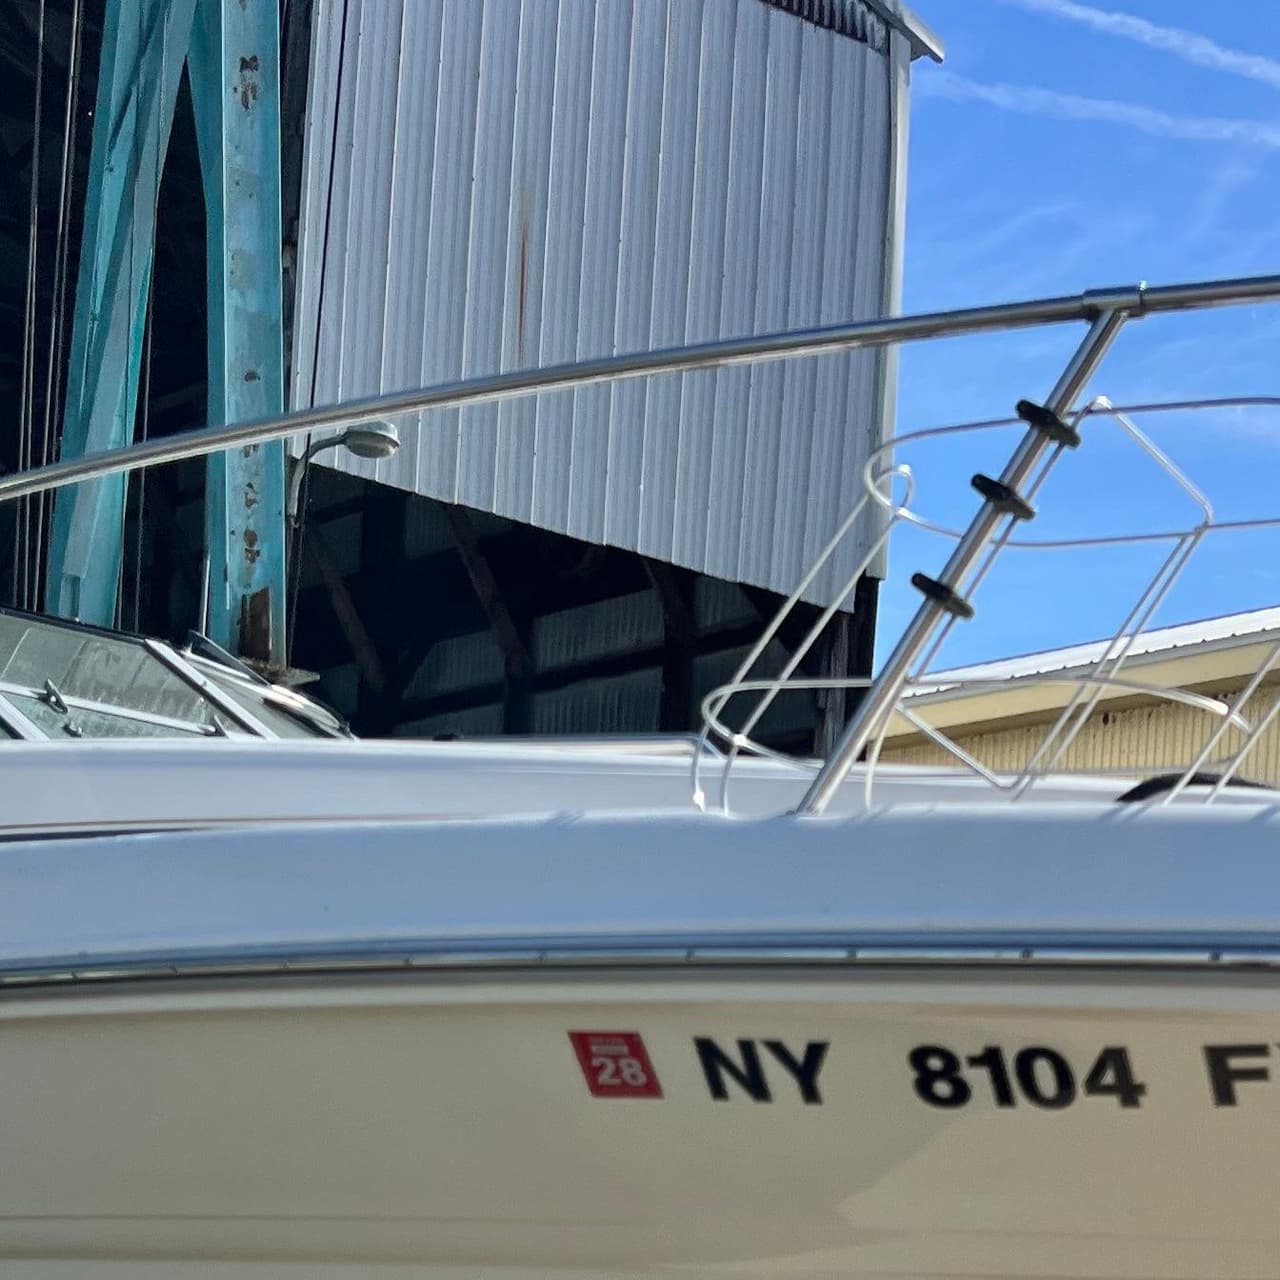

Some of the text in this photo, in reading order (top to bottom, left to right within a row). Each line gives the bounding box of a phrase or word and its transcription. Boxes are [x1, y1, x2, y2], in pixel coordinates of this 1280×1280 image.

[591, 1056, 648, 1088] 28
[693, 1037, 830, 1105] NY
[908, 1044, 1146, 1109] 8104
